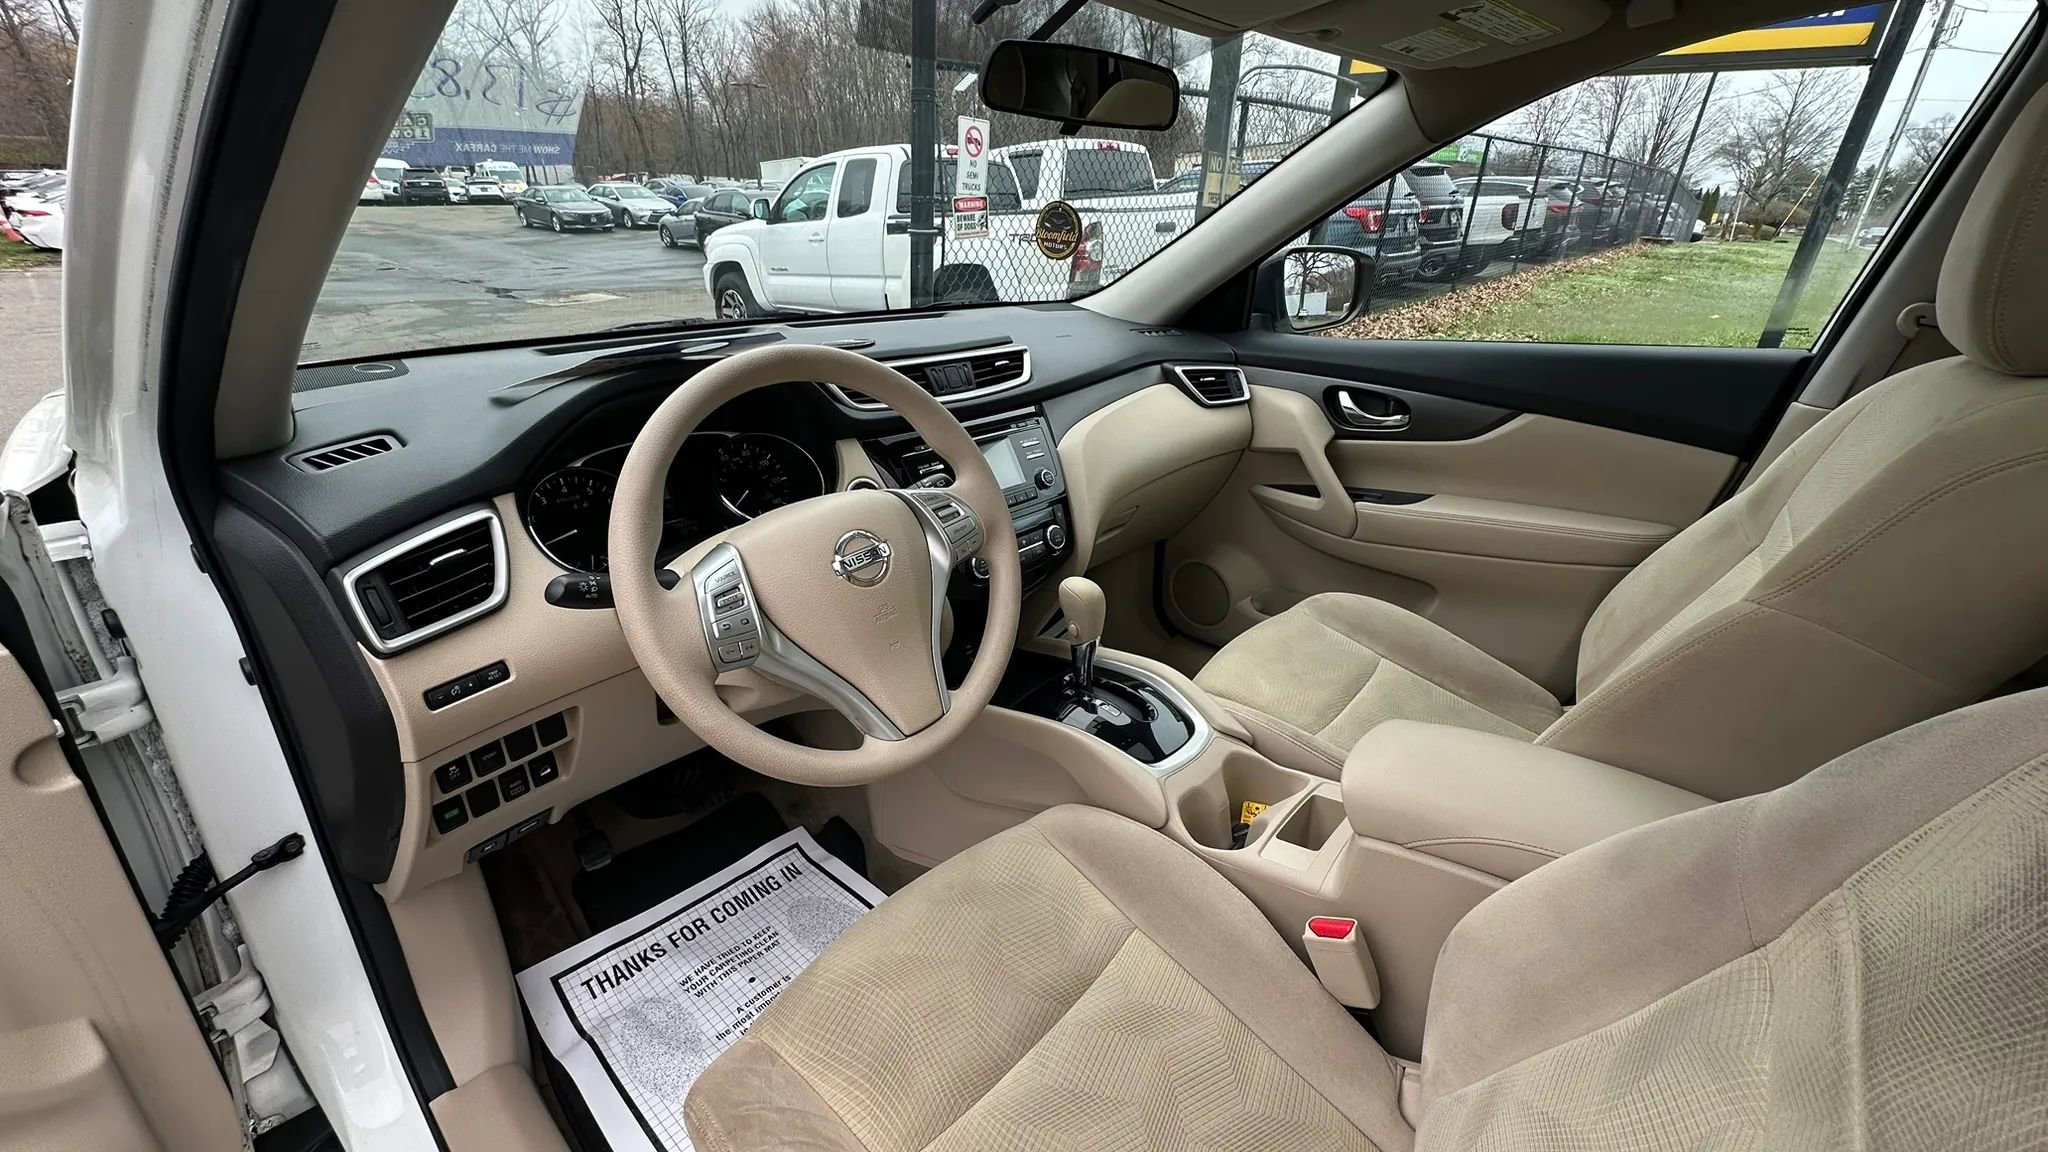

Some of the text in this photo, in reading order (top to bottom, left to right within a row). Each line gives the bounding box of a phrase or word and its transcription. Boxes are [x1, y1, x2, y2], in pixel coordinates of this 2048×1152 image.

[968, 159, 978, 169] NO
[1209, 155, 1241, 174] NOCE
[966, 171, 979, 180] SEMI
[961, 182, 981, 192] TRUCKS
[958, 200, 984, 210] WARNING
[956, 213, 976, 222] BEWARE
[956, 221, 977, 231] OF DOGS
[1035, 227, 1079, 243] Bloomfield
[1043, 241, 1067, 250] MOTORS
[587, 487, 593, 496] 5
[540, 496, 547, 505] 3
[842, 544, 888, 570] NISSAN
[714, 571, 737, 584] SOURCE
[581, 862, 803, 1000] THANKS FOR COMING IN
[679, 925, 772, 987] WE HAVE TRIED TO KEEP
[684, 930, 779, 994] YOUR CARPETING CLEAN
[694, 939, 781, 998] WITH THIS PAPER MAT
[736, 974, 792, 1014] A customer is
[716, 1028, 732, 1041] the
[732, 1010, 755, 1030] most
